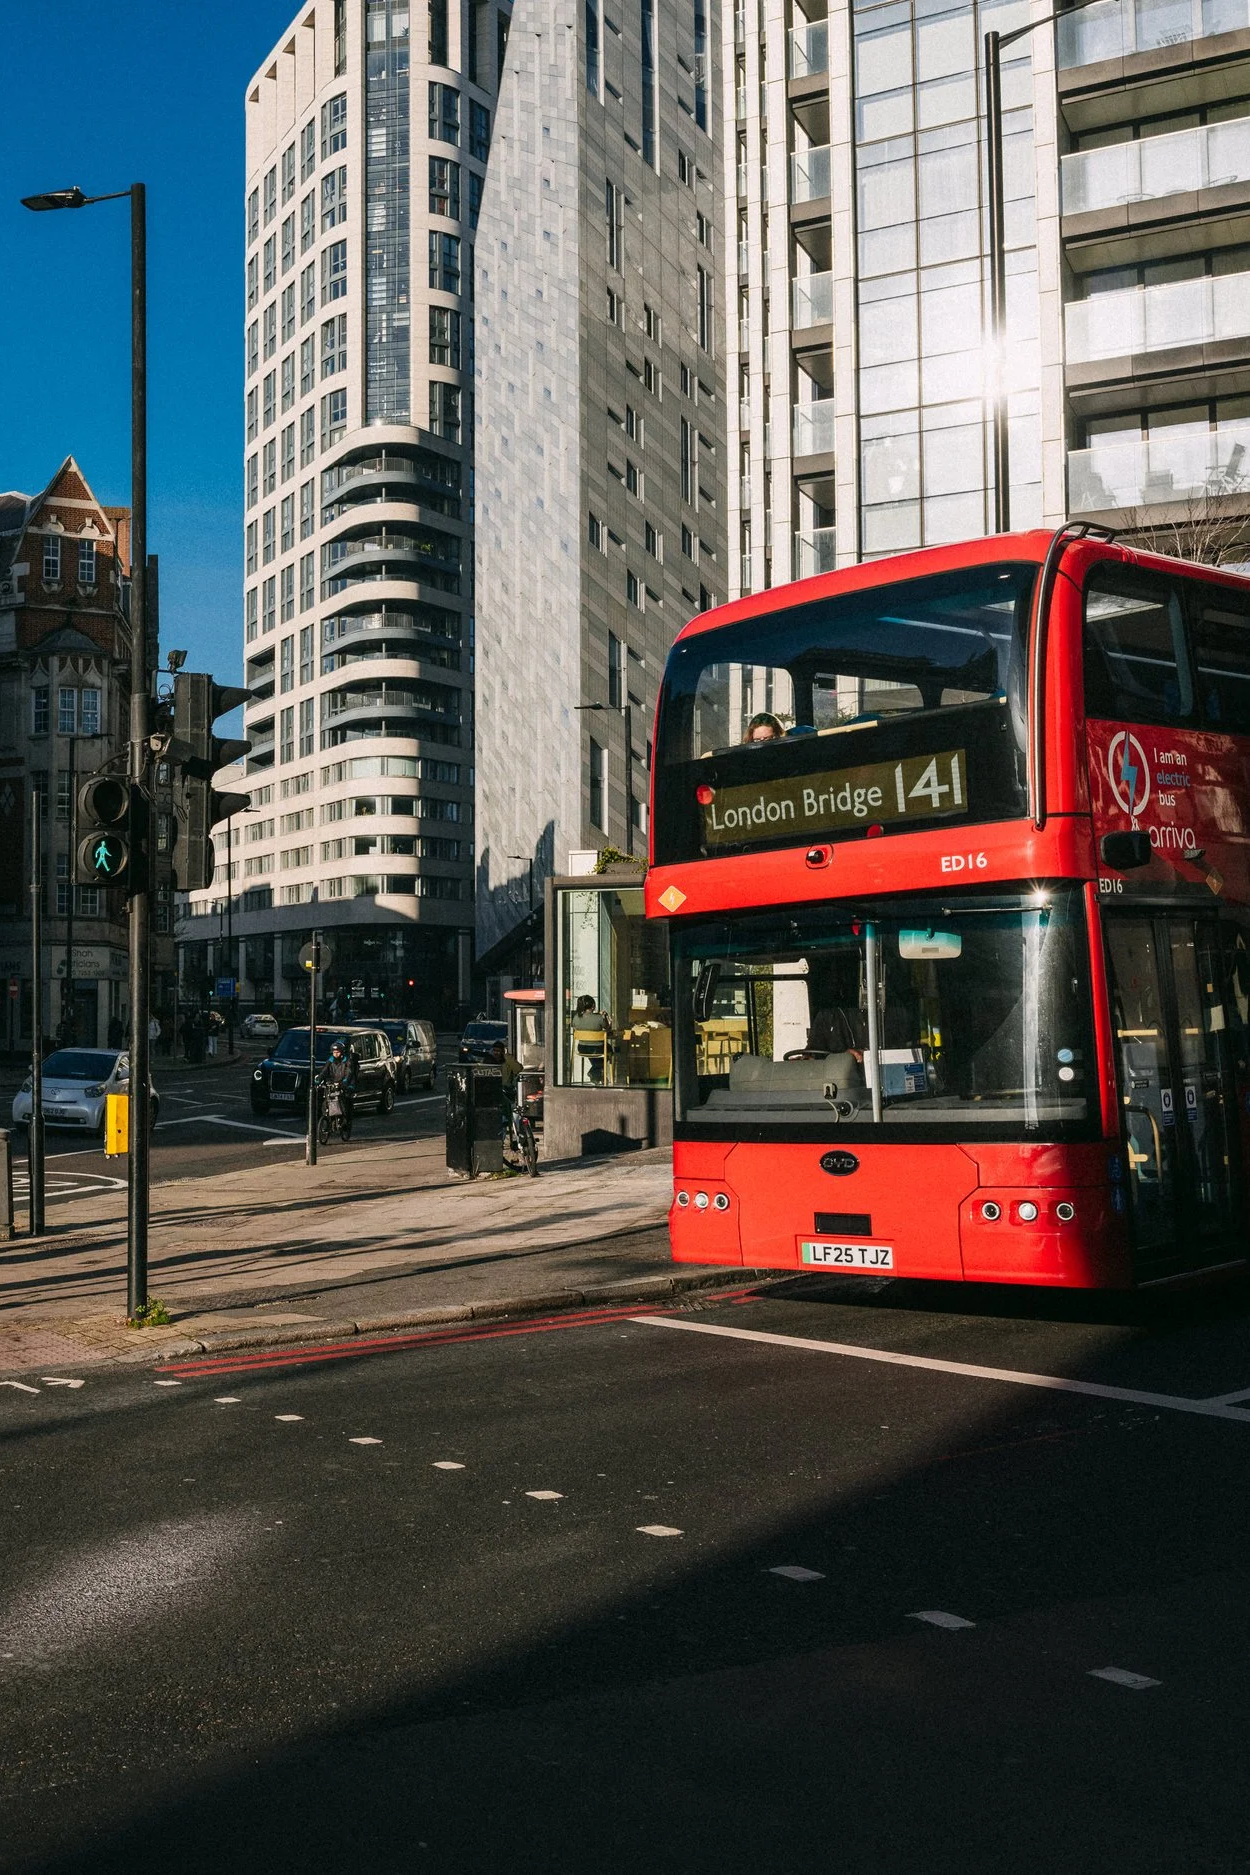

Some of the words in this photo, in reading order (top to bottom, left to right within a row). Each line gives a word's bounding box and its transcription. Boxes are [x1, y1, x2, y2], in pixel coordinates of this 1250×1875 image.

[1154, 747, 1158, 763] I
[1160, 751, 1174, 765] am
[1176, 753, 1187, 766] an
[1156, 769, 1191, 787] electric
[711, 796, 795, 830] London
[803, 782, 882, 817] Bridge
[895, 753, 962, 813] 141
[1158, 790, 1176, 806] bus
[1149, 821, 1196, 849] arriva
[941, 852, 987, 872] ED16
[1099, 878, 1123, 893] ED16
[813, 1246, 854, 1263] LF25
[858, 1248, 890, 1265] TJZ
